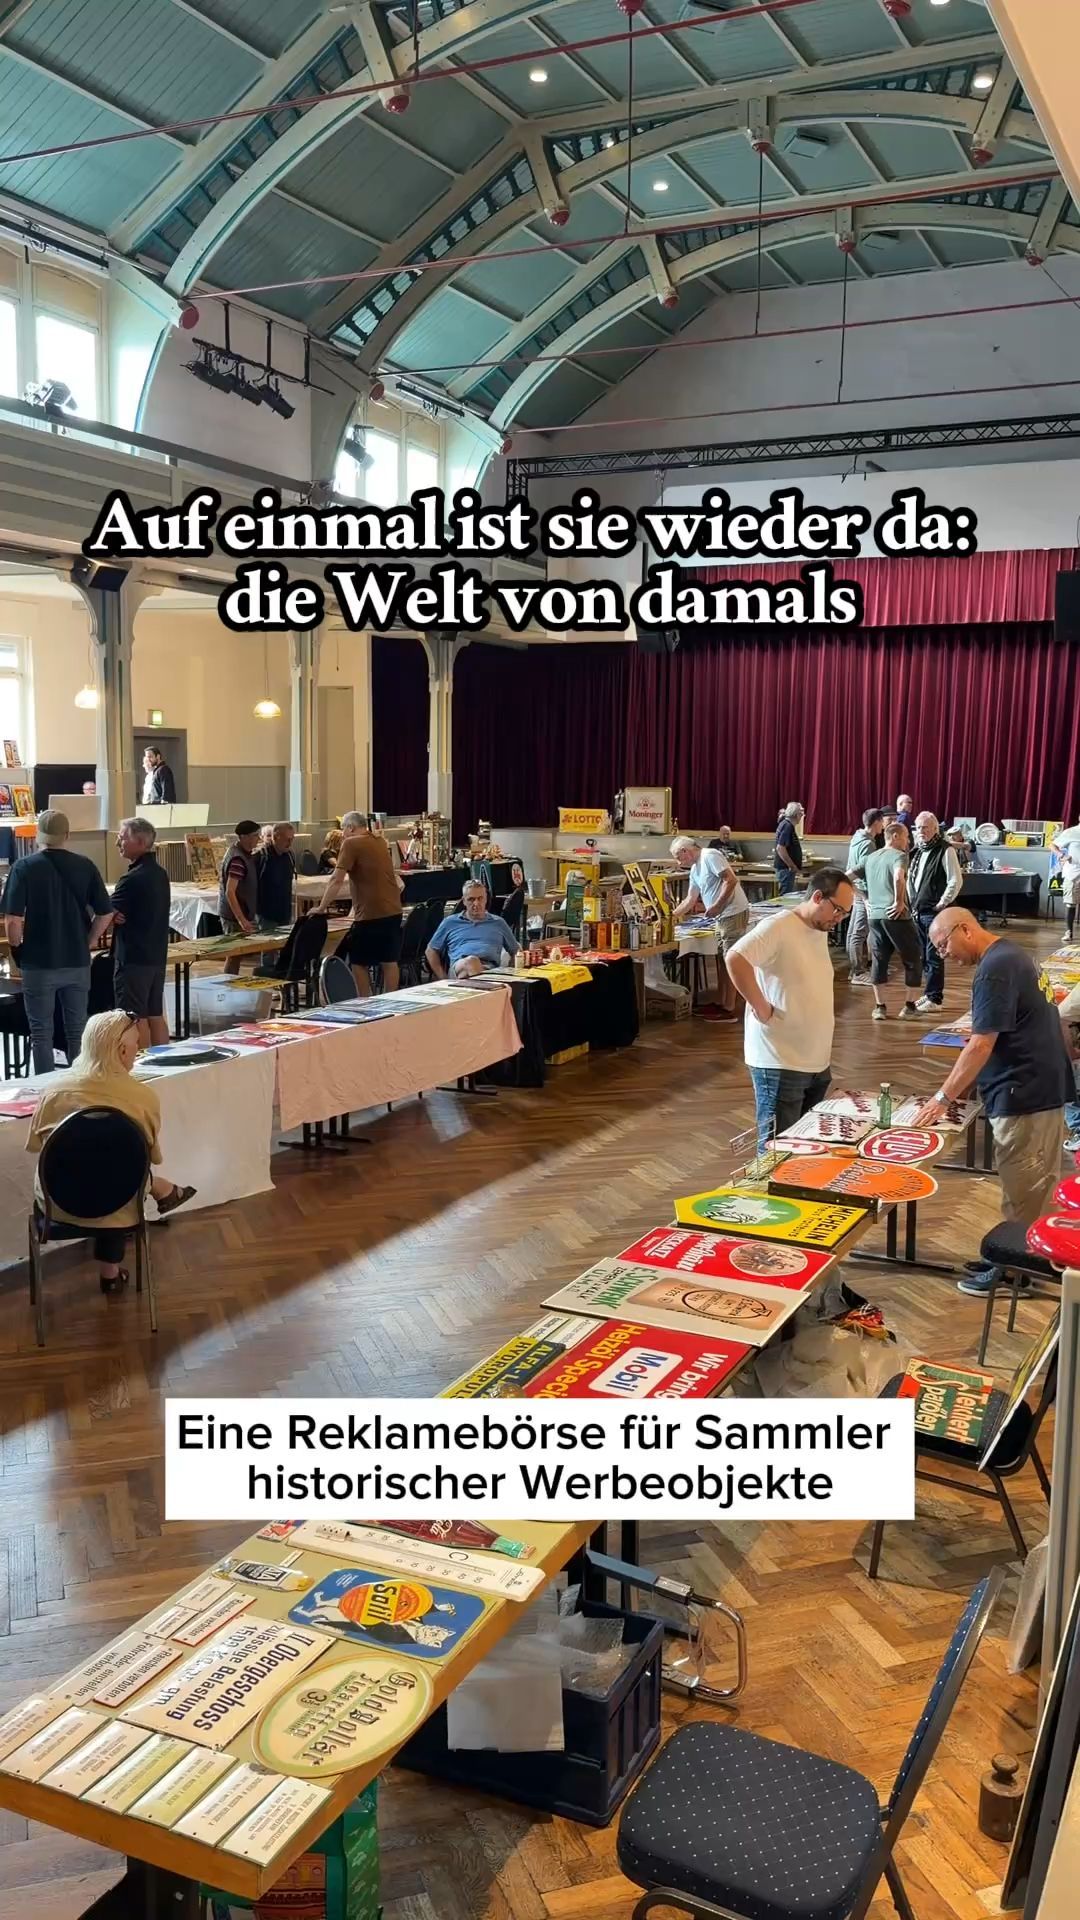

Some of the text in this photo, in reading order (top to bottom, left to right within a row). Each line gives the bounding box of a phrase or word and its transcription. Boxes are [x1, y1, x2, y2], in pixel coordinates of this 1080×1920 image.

[574, 815, 602, 824] LOTTO
[629, 810, 664, 820] Moninger
[804, 1207, 857, 1242] MICHELIN
[576, 1268, 608, 1286] ULM
[587, 1271, 659, 1310] SCHWENK
[591, 1323, 648, 1362] Heizöl
[606, 1352, 669, 1392] Mobil
[697, 1353, 729, 1372] Wir
[944, 1391, 990, 1443] Teichert
[188, 1617, 217, 1637] verboten
[74, 1666, 115, 1698] einstellen
[82, 1651, 119, 1677] verboten
[106, 1650, 172, 1699] Rauchen verboten
[166, 1624, 285, 1720] zulässige Belastung
[193, 1643, 301, 1731] Obergeschoss
[294, 1672, 381, 1738] Zigaretten
[361, 1671, 418, 1713] Gold
[302, 1708, 380, 1767] Dollar
